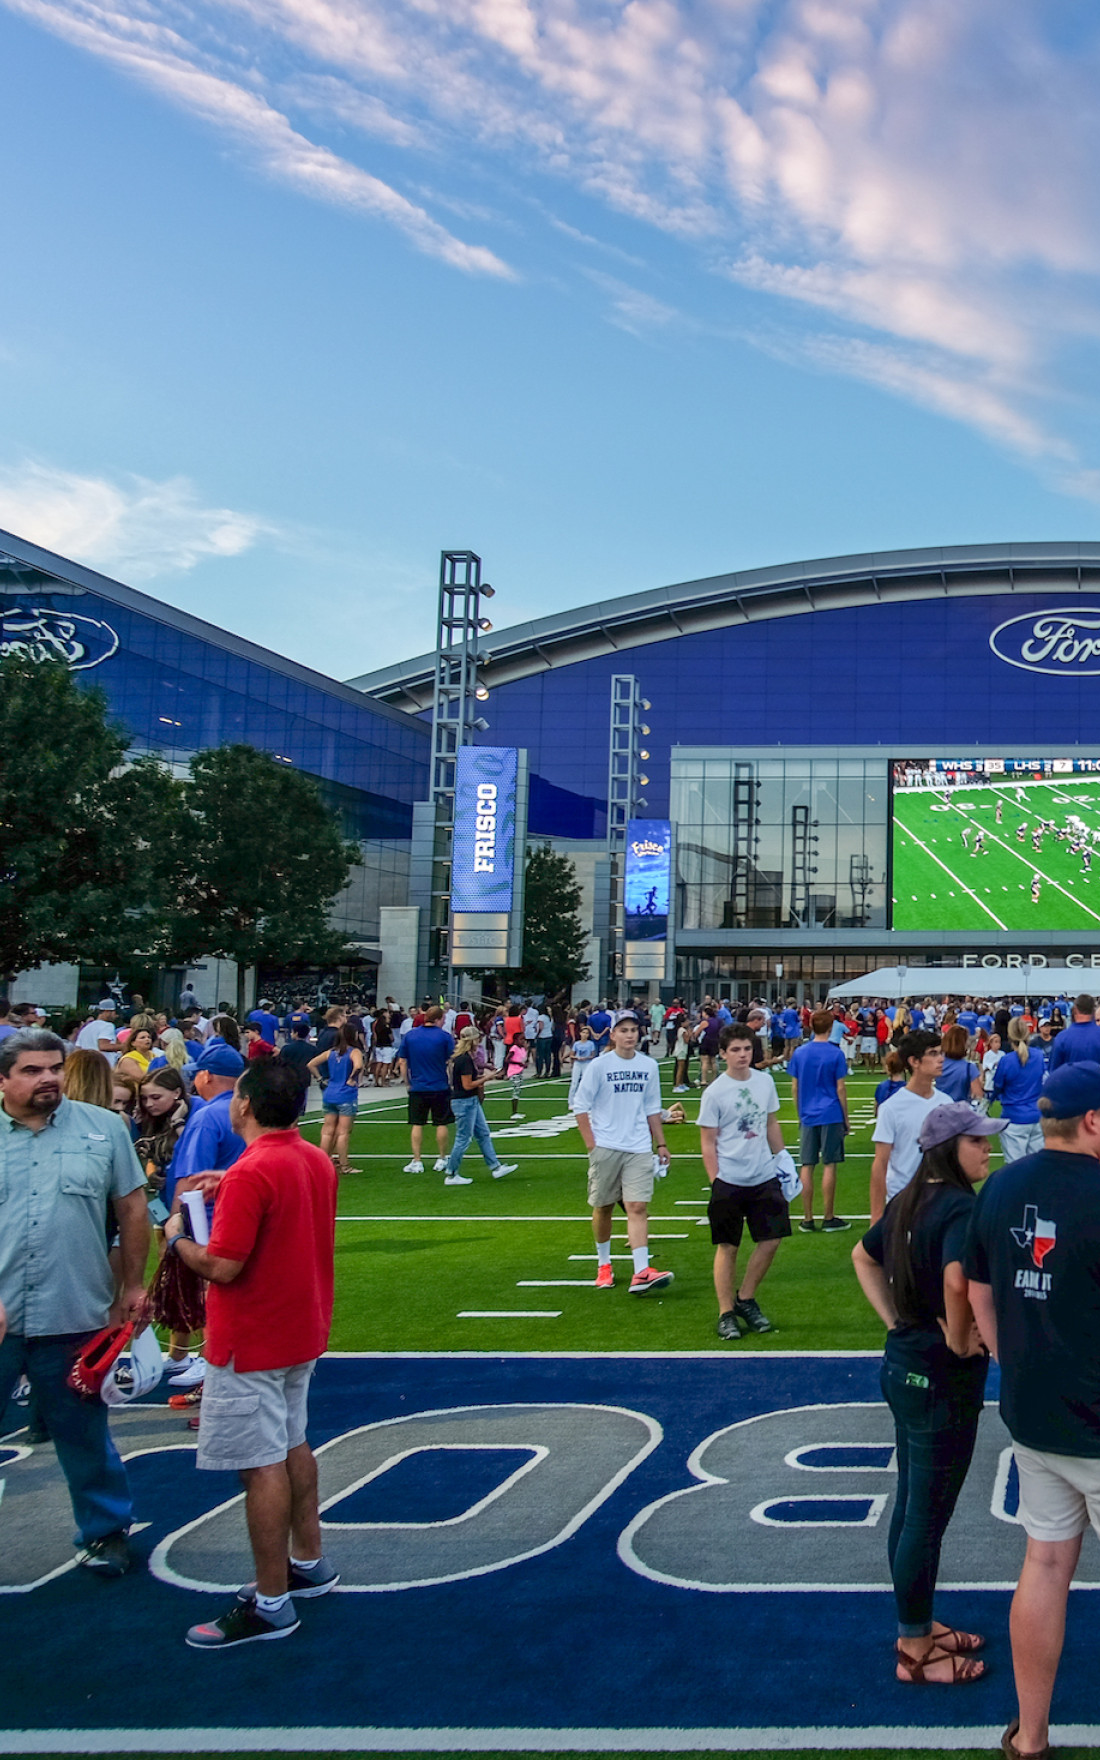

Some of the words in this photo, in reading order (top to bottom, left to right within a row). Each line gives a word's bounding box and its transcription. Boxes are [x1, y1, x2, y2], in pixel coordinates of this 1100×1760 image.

[941, 761, 973, 770] WHS
[1014, 761, 1041, 770] LHS
[474, 783, 497, 873] FRISCO
[962, 954, 1047, 968] FORD
[606, 1071, 649, 1082] REDHAWK
[614, 1083, 644, 1093] NATION
